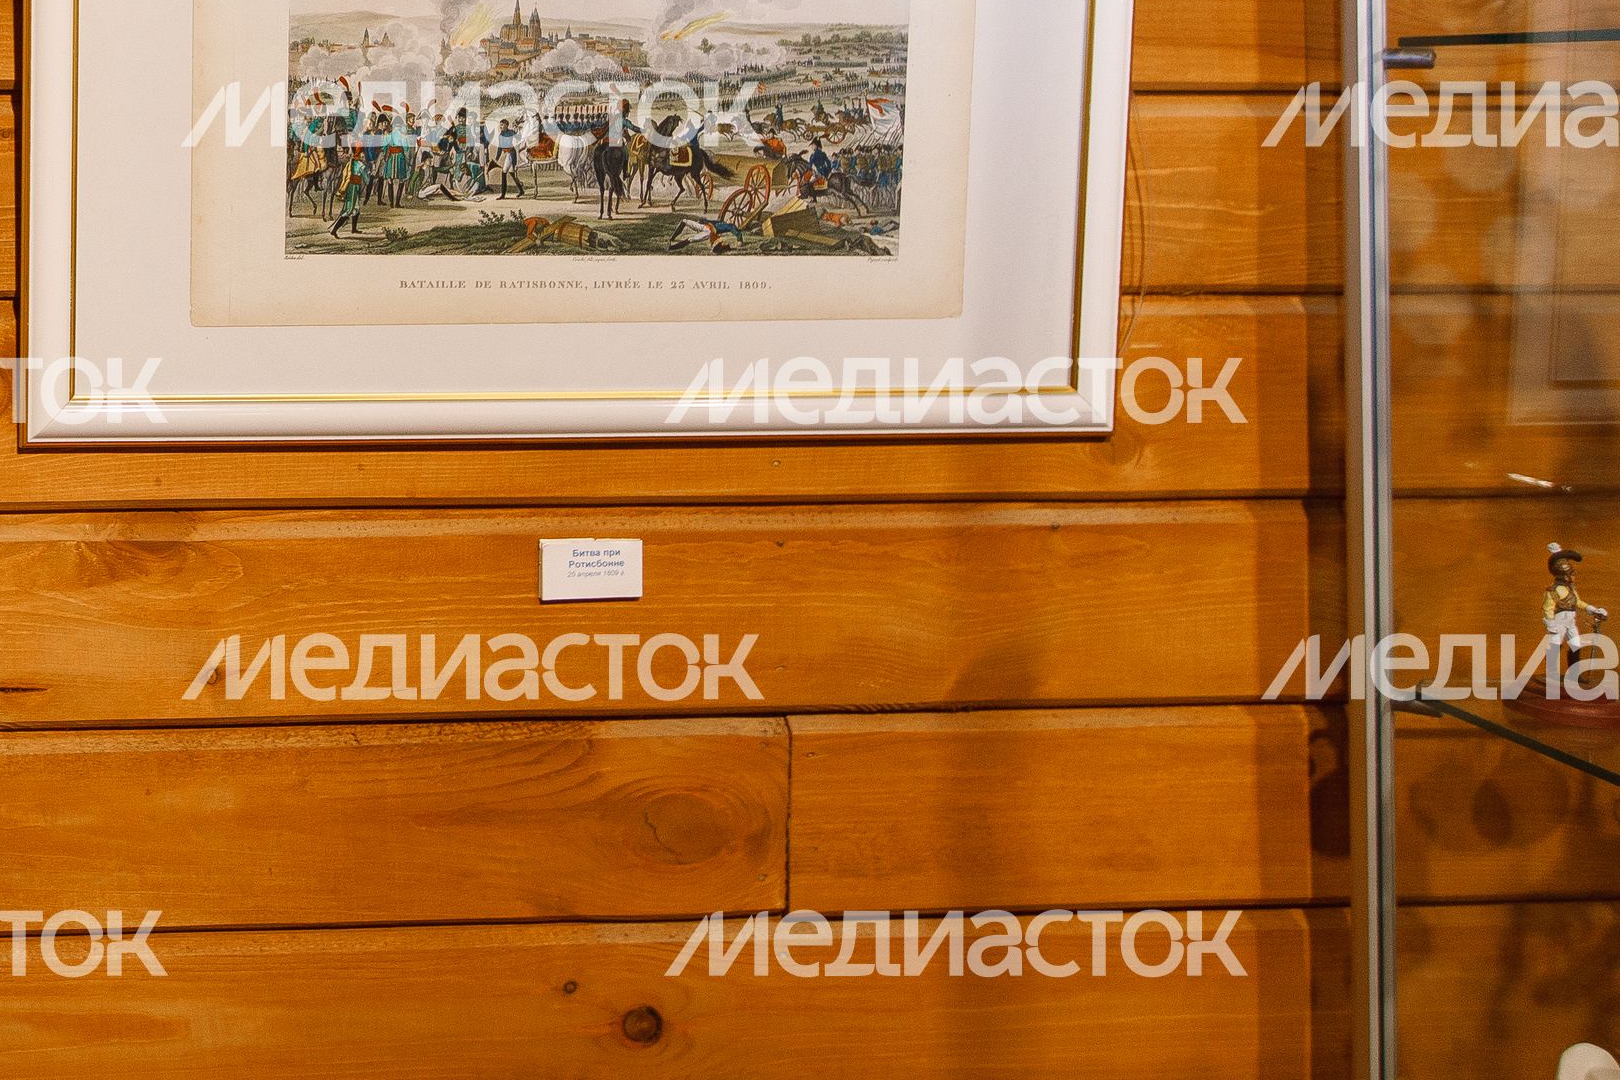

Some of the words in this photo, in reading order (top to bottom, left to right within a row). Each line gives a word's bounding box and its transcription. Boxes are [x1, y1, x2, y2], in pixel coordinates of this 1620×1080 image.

[399, 280, 466, 289] BATAILLE
[475, 280, 492, 289] DE
[499, 280, 588, 291] RATISBONNE,
[593, 278, 640, 289] LIVRÉE
[648, 281, 663, 289] LE
[692, 281, 730, 289] AVRIL
[739, 281, 772, 289] 1809.
[572, 549, 600, 557] Битва
[603, 549, 620, 558] при
